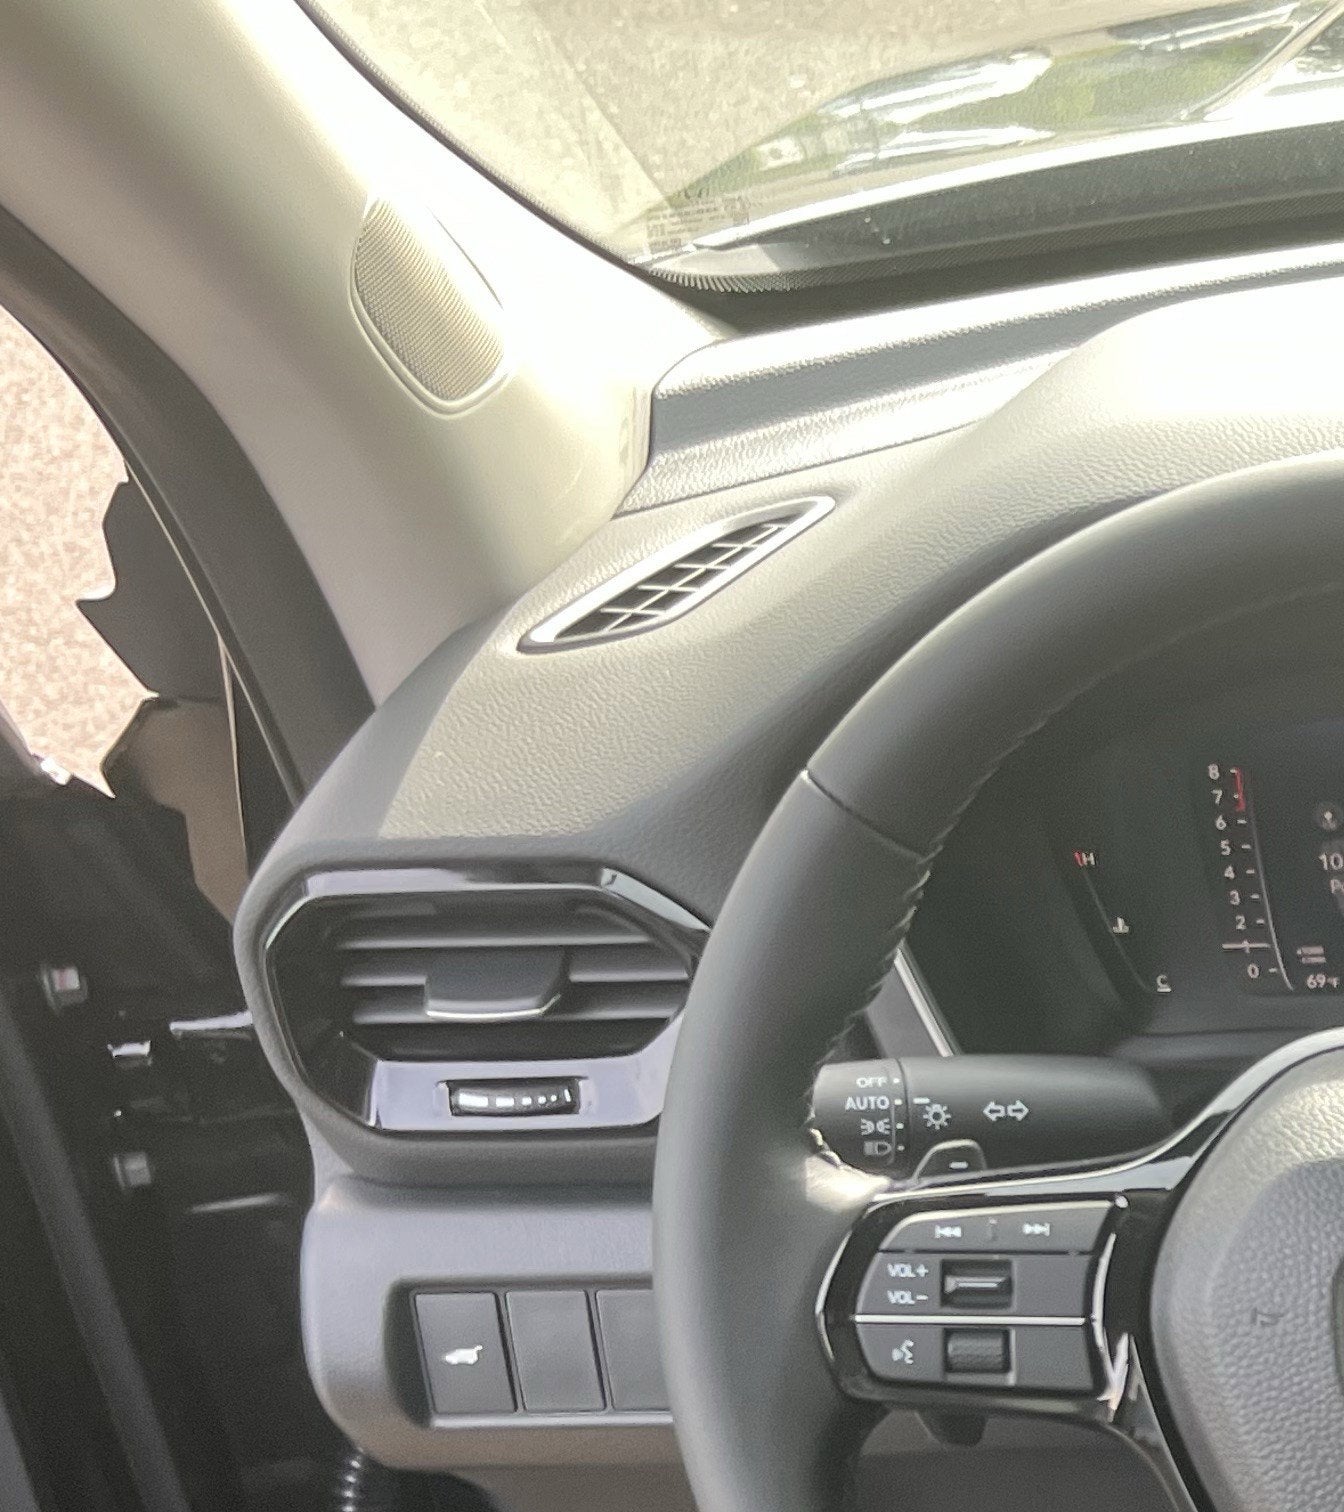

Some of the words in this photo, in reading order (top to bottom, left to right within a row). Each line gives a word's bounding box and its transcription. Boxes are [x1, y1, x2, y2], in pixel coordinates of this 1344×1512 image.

[1207, 764, 1220, 781] 8
[1211, 789, 1223, 805] 7
[1215, 815, 1227, 831] 6
[1220, 839, 1231, 856] 5
[1224, 865, 1236, 880] 4
[1229, 890, 1241, 906] 3
[1235, 915, 1247, 930] 2
[1247, 963, 1260, 979] 0
[856, 1077, 887, 1088] OFF
[845, 1096, 889, 1111] AUTO
